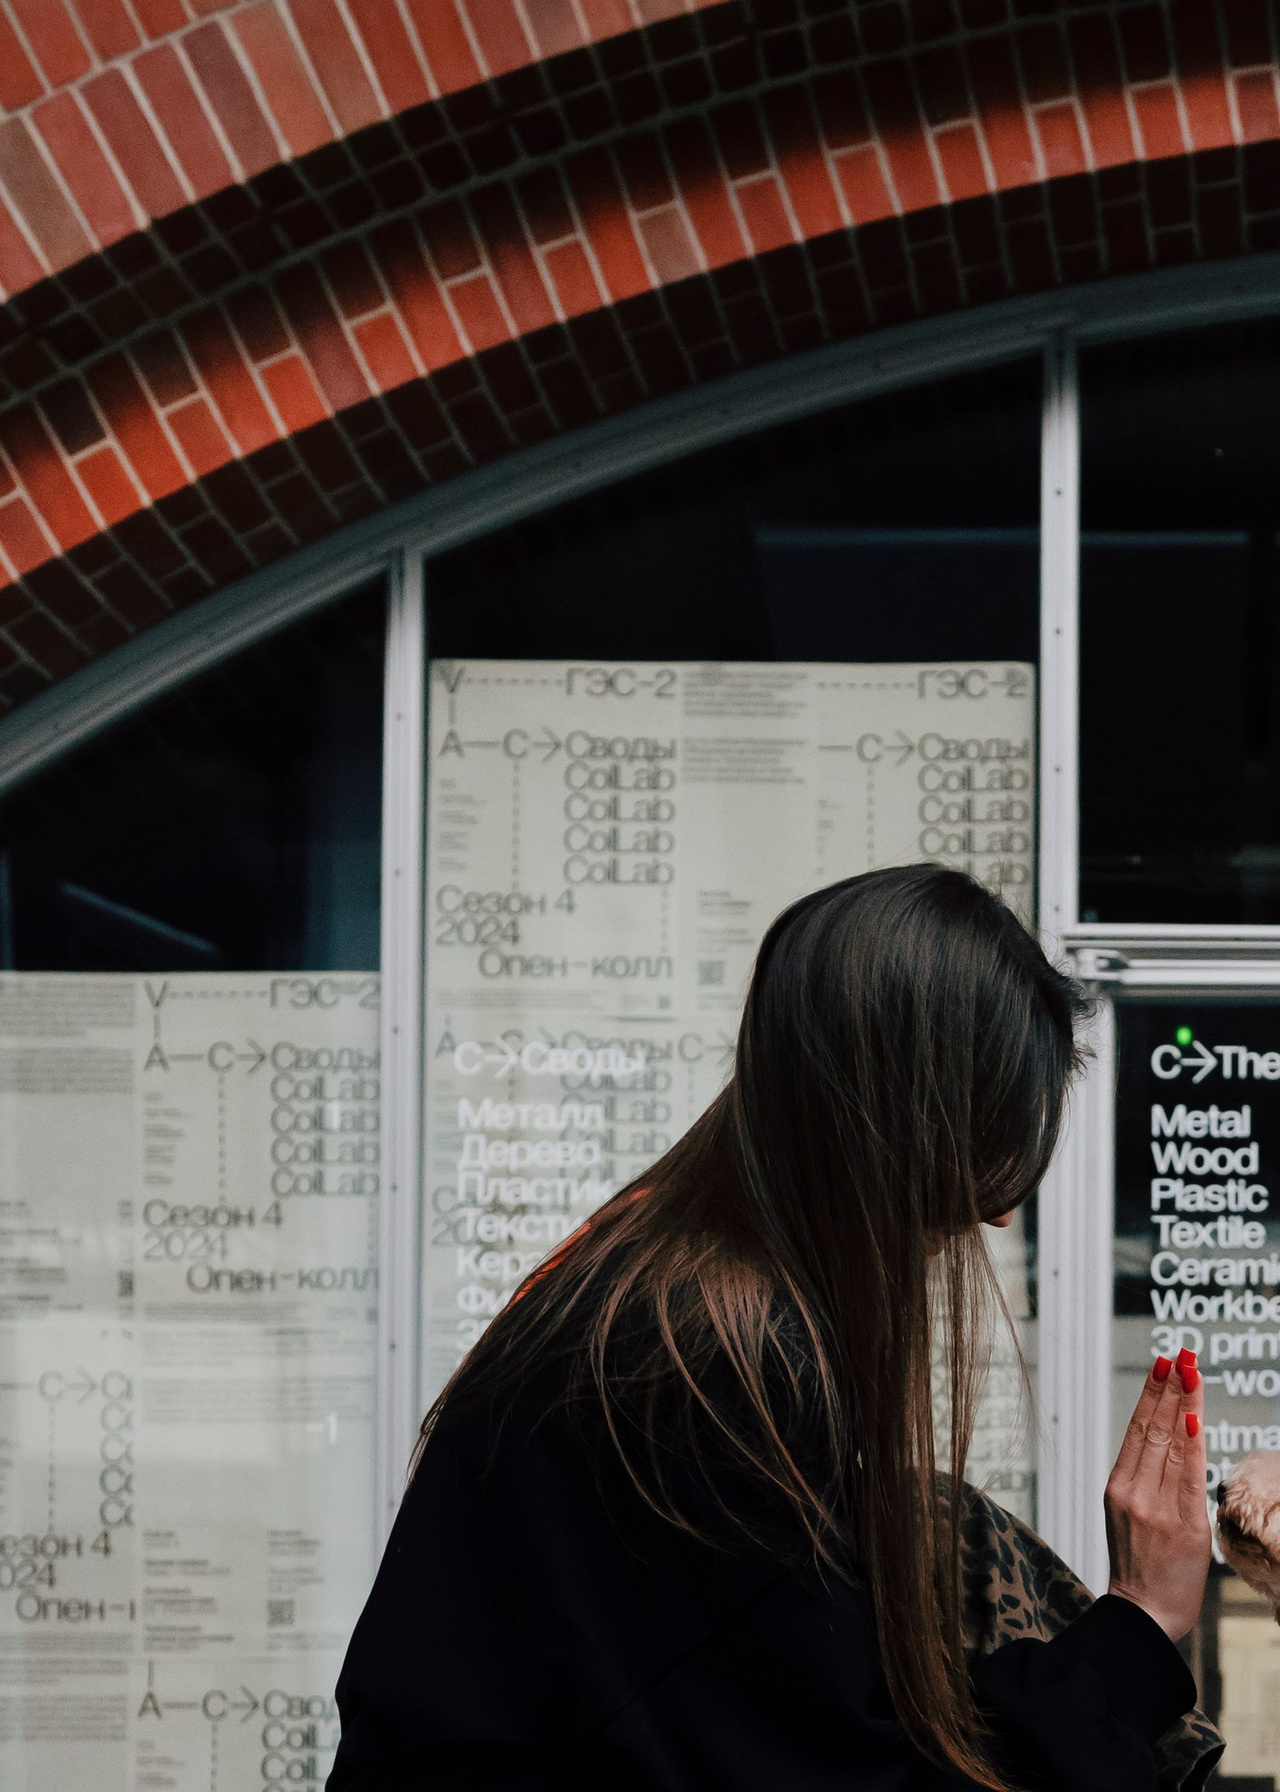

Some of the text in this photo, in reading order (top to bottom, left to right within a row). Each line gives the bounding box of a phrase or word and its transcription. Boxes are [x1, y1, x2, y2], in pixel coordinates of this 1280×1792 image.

[565, 668, 677, 698] ГЭС-2
[565, 729, 676, 764] Своды
[917, 732, 1029, 766] Своды
[436, 884, 576, 916] Сезон 4
[436, 915, 520, 946] 2024
[520, 1041, 647, 1085] Своды
[456, 1098, 604, 1131] Металл
[1151, 1104, 1251, 1138] Metal
[457, 1133, 601, 1173] Дерево
[1151, 1141, 1260, 1175] Wood
[1151, 1178, 1269, 1213] Plastic
[143, 1200, 285, 1230] Сезон 4
[1151, 1214, 1267, 1250] Textile
[143, 1229, 228, 1262] 2024
[90, 1531, 112, 1558] 4
